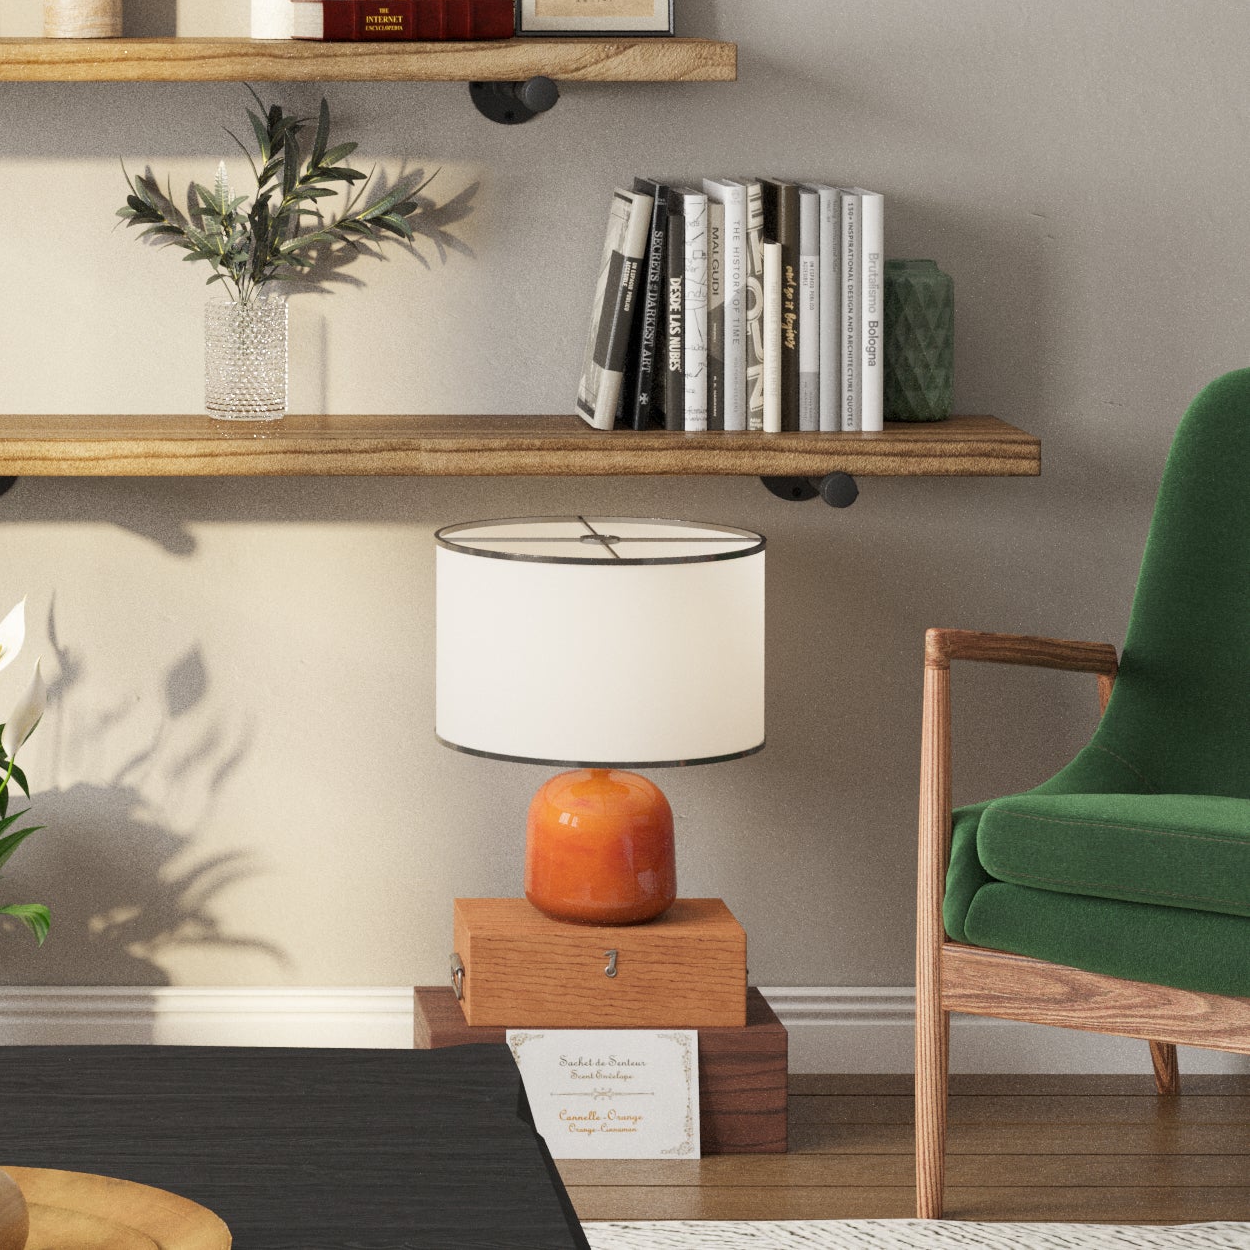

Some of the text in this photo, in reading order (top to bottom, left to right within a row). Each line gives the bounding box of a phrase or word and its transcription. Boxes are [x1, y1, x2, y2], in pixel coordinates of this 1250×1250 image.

[365, 16, 404, 24] INTERNET
[650, 230, 664, 282] SECRETS
[712, 226, 720, 296] MALGUDI
[622, 260, 632, 287] ACCESIBLE
[784, 266, 796, 310] and so it
[644, 292, 657, 347] DARKEST
[733, 300, 740, 314] OF
[866, 252, 880, 366] Brutalismo Bologna
[670, 314, 681, 334] LAS
[642, 350, 652, 373] ART
[846, 395, 854, 427] QUOTES
[558, 1054, 647, 1067] Sachet de Senteur
[570, 1069, 594, 1080] Scent
